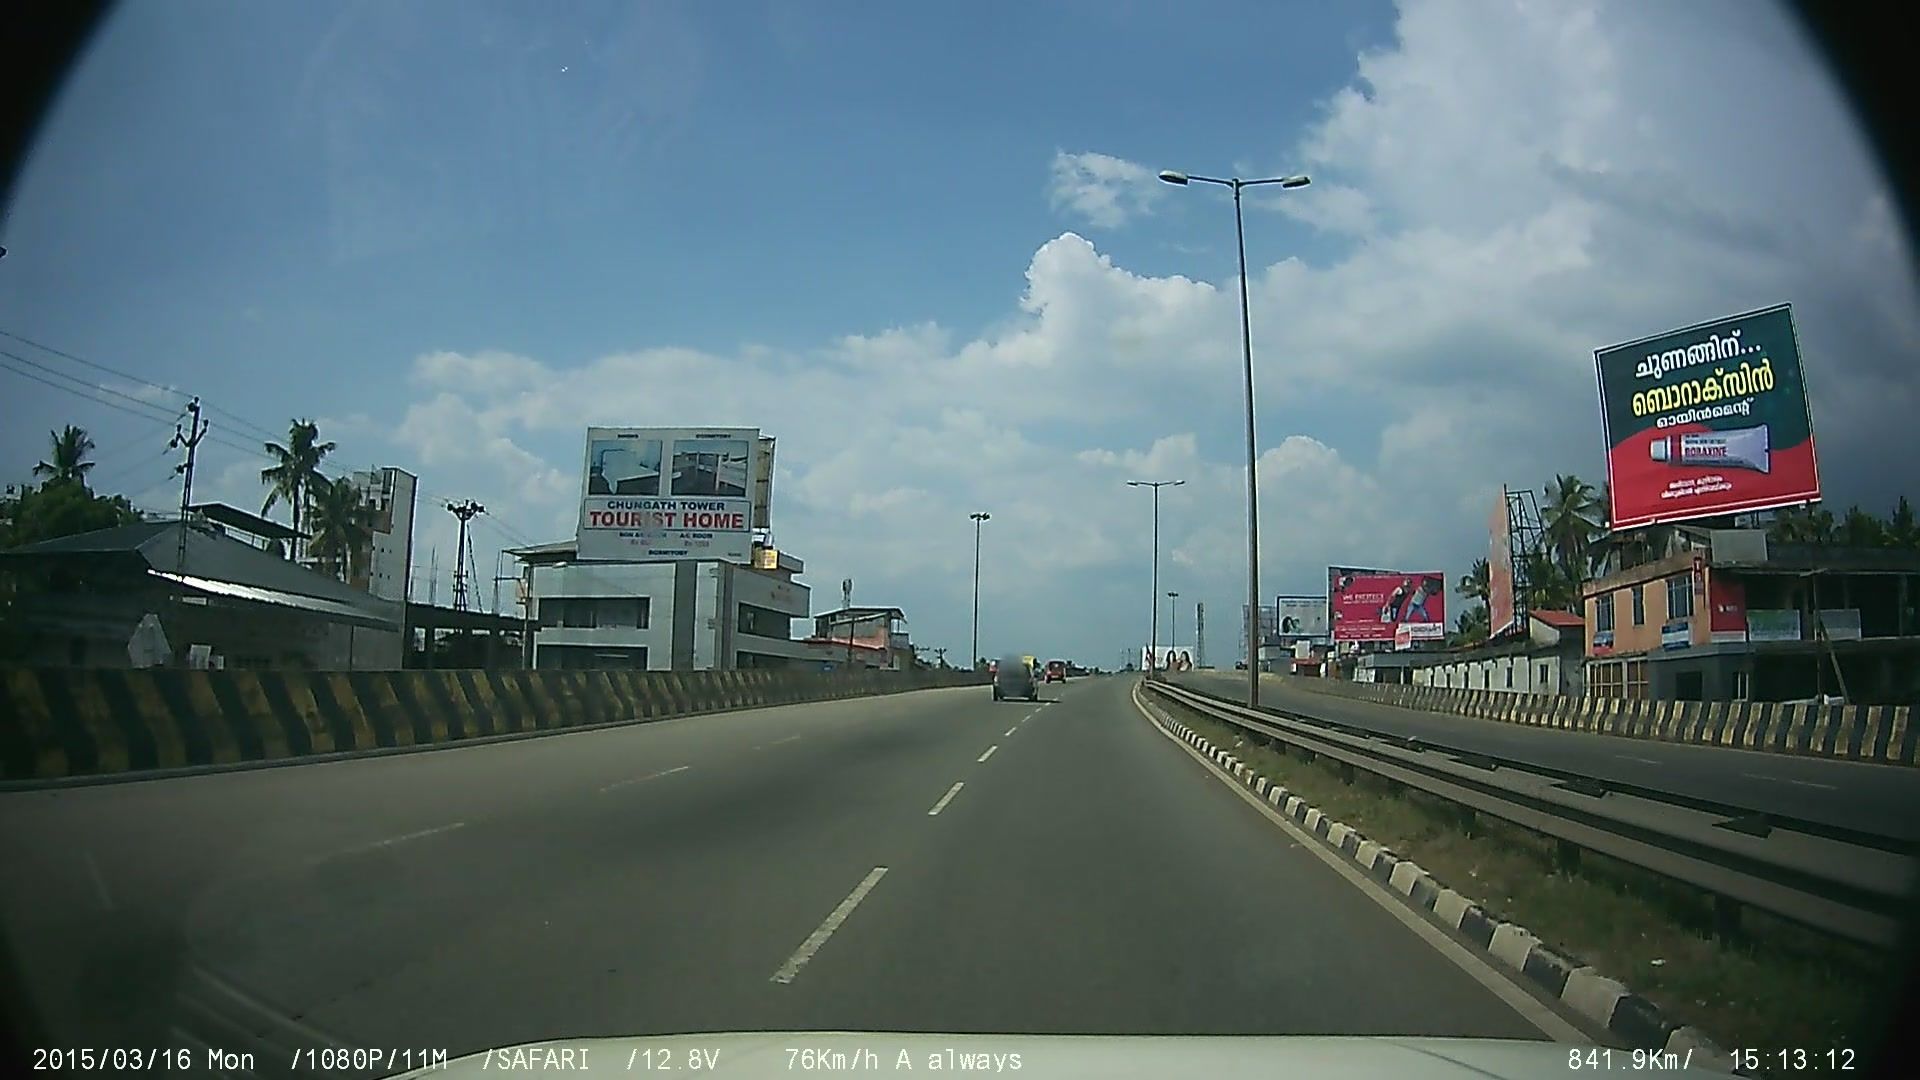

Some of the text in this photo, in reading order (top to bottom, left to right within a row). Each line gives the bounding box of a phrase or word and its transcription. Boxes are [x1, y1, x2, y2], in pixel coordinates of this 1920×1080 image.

[607, 501, 725, 511] CHUNGATH TOWER
[590, 511, 744, 529] TOURST HOME
